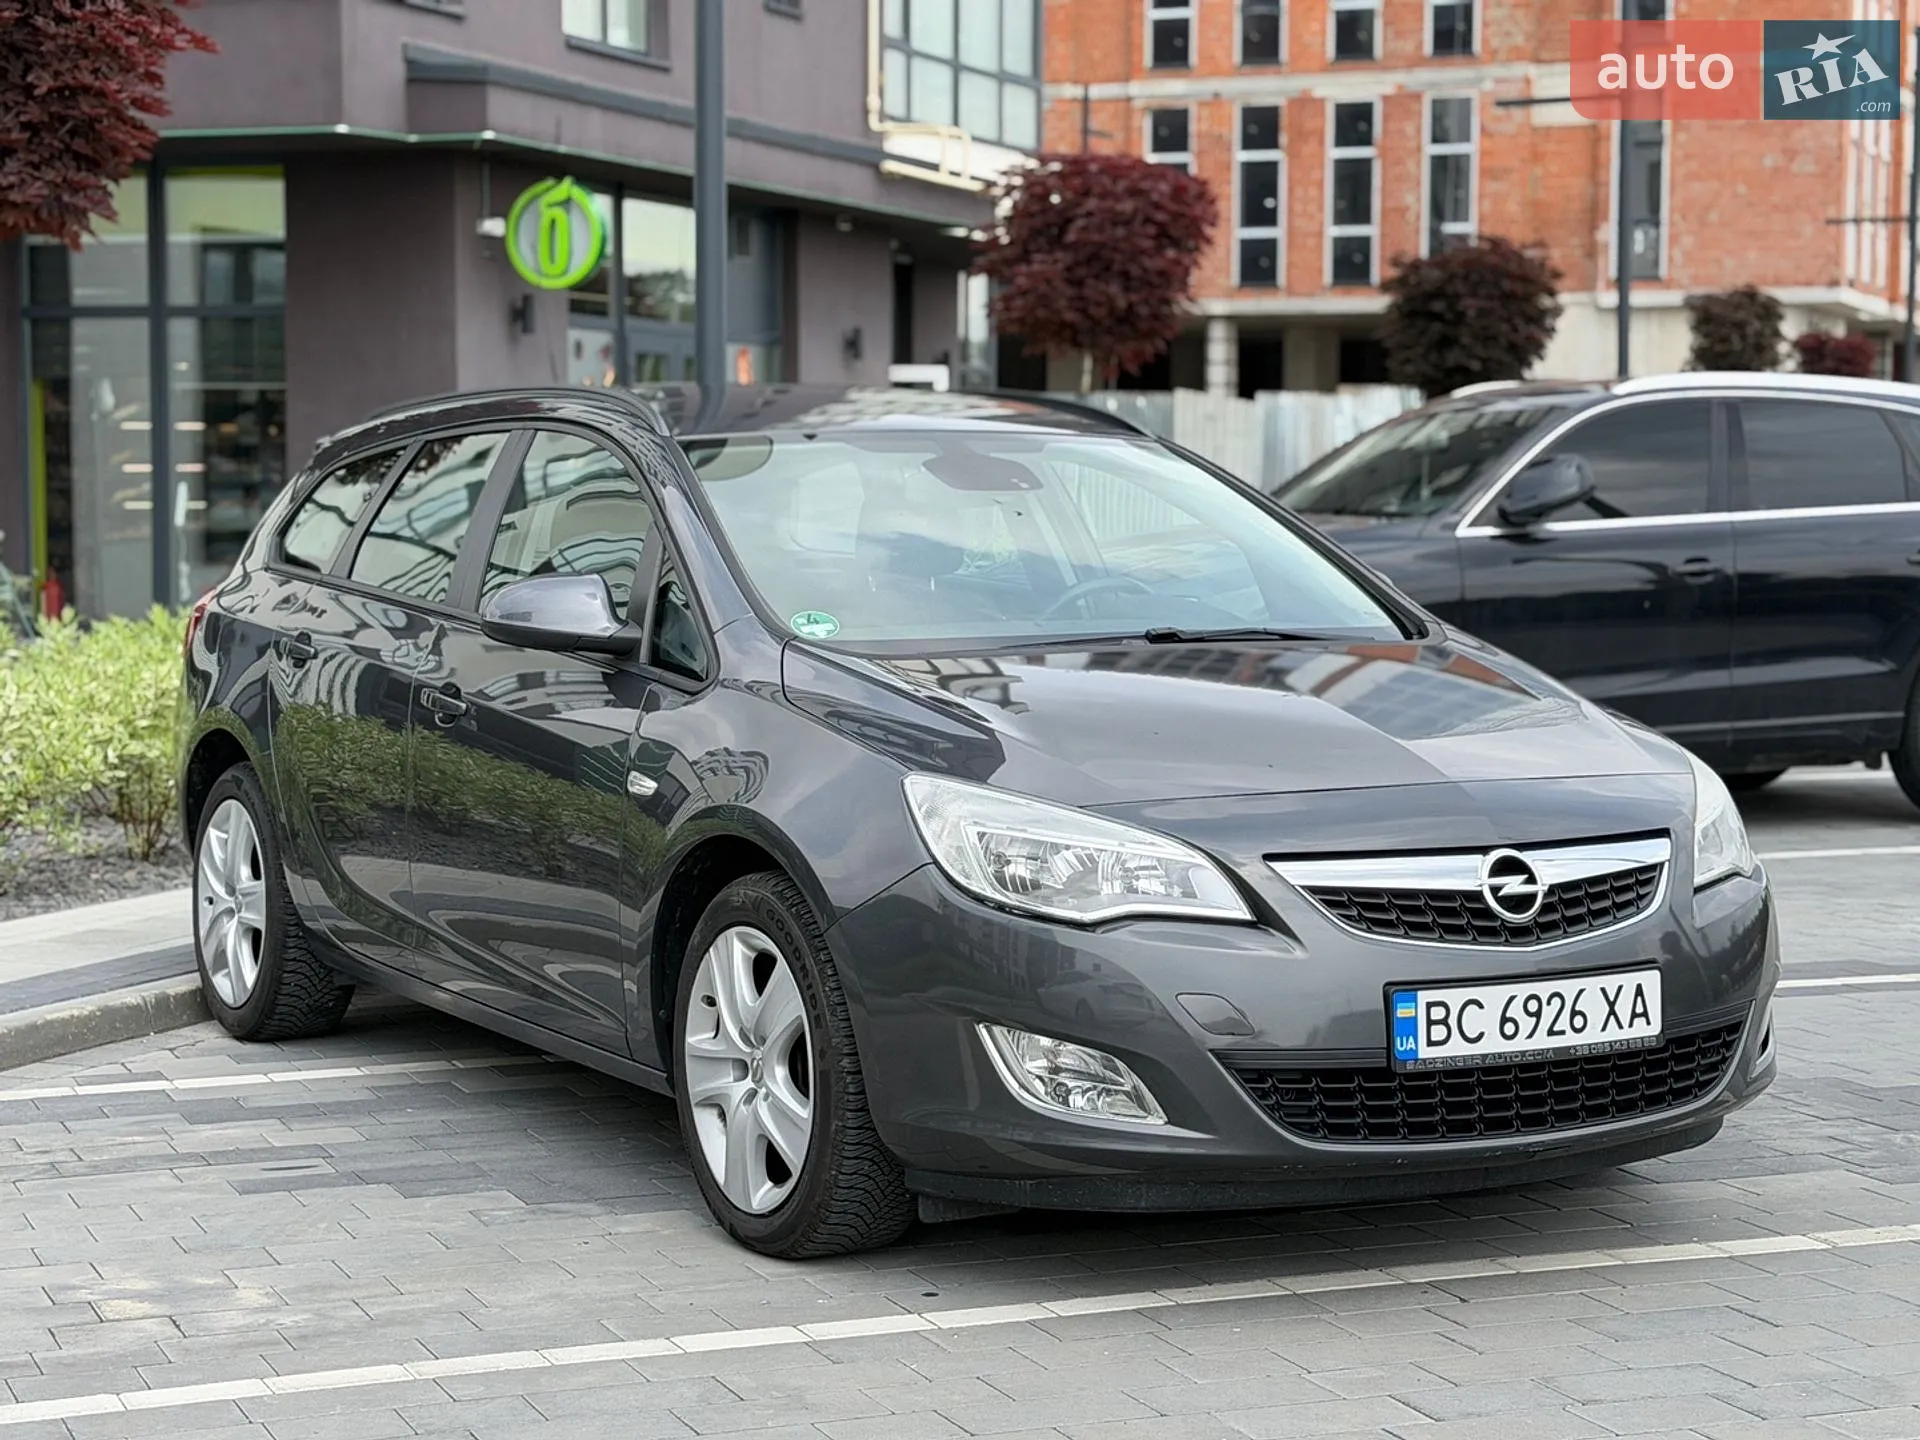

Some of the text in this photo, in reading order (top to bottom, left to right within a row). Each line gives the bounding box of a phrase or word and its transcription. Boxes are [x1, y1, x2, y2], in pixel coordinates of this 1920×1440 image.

[1425, 983, 1652, 1047] BC 6926 XA
[1397, 1036, 1416, 1051] UA
